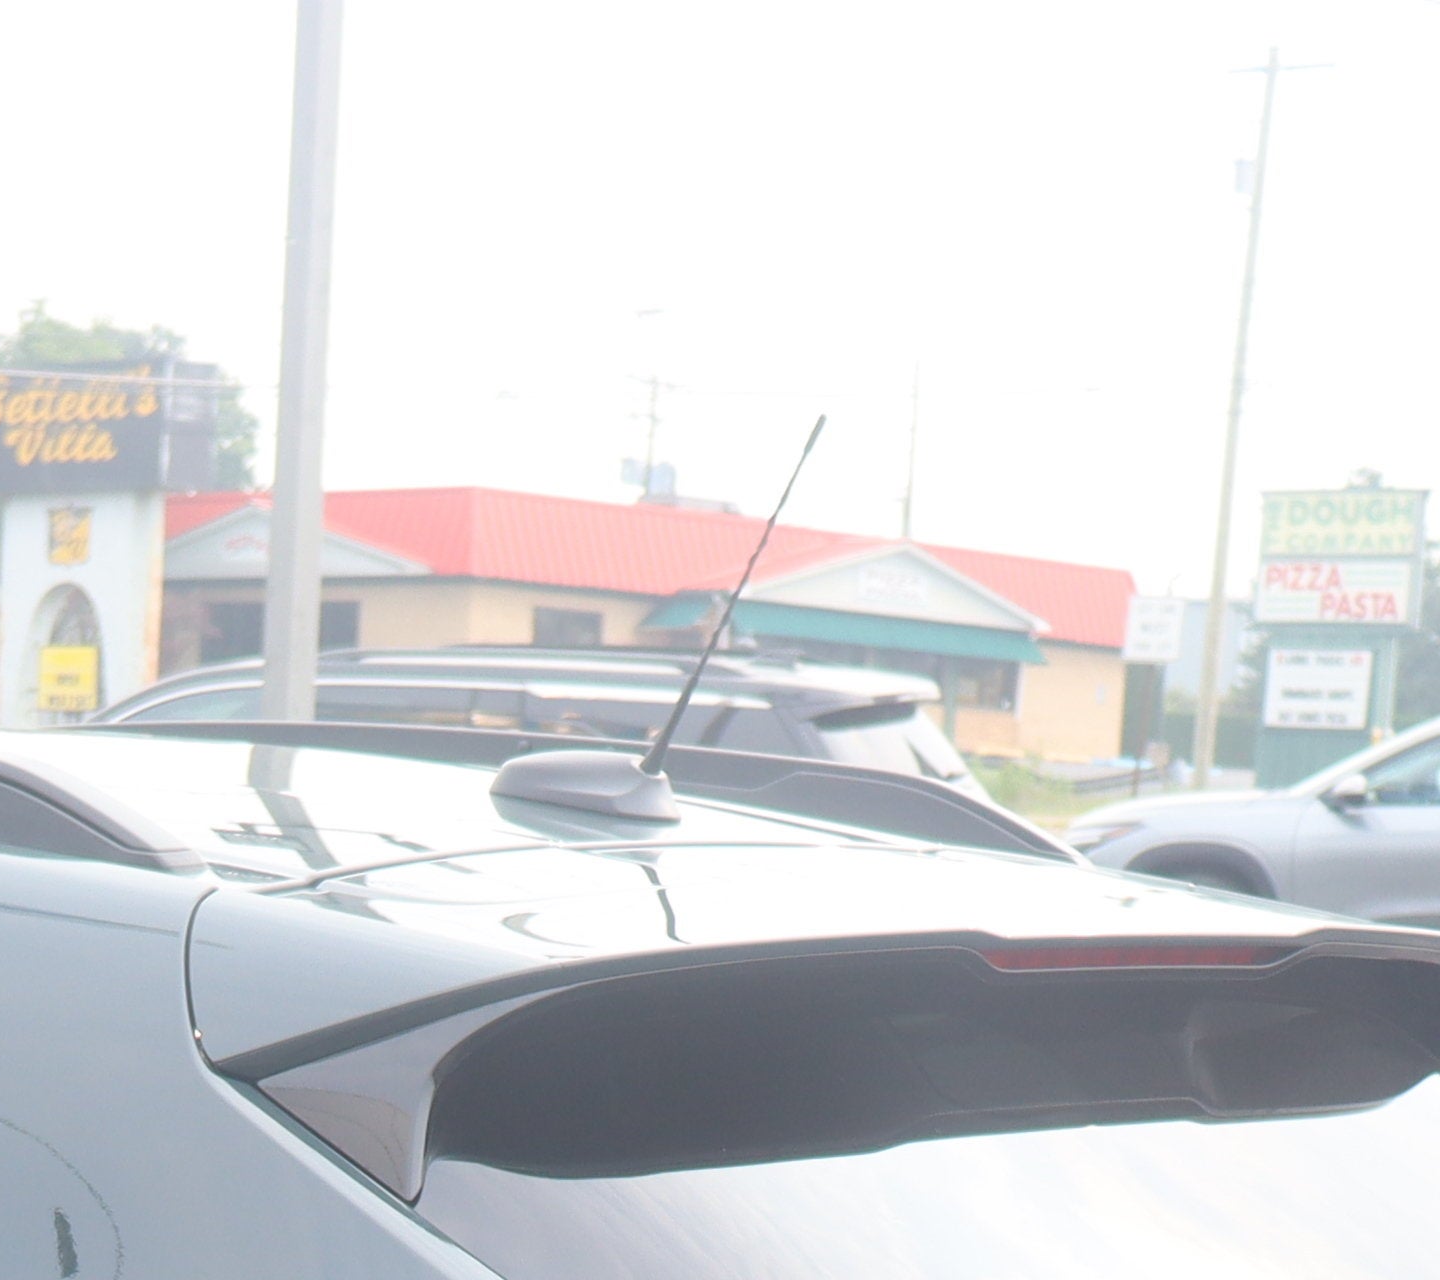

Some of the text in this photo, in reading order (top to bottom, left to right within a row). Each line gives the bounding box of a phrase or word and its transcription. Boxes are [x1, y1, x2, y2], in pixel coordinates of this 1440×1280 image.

[3, 423, 118, 466] Villa
[1288, 498, 1413, 526] DOUGH
[1286, 531, 1411, 551] COMPANY
[1265, 563, 1341, 591] PIZZA
[1320, 592, 1398, 619] PASTA
